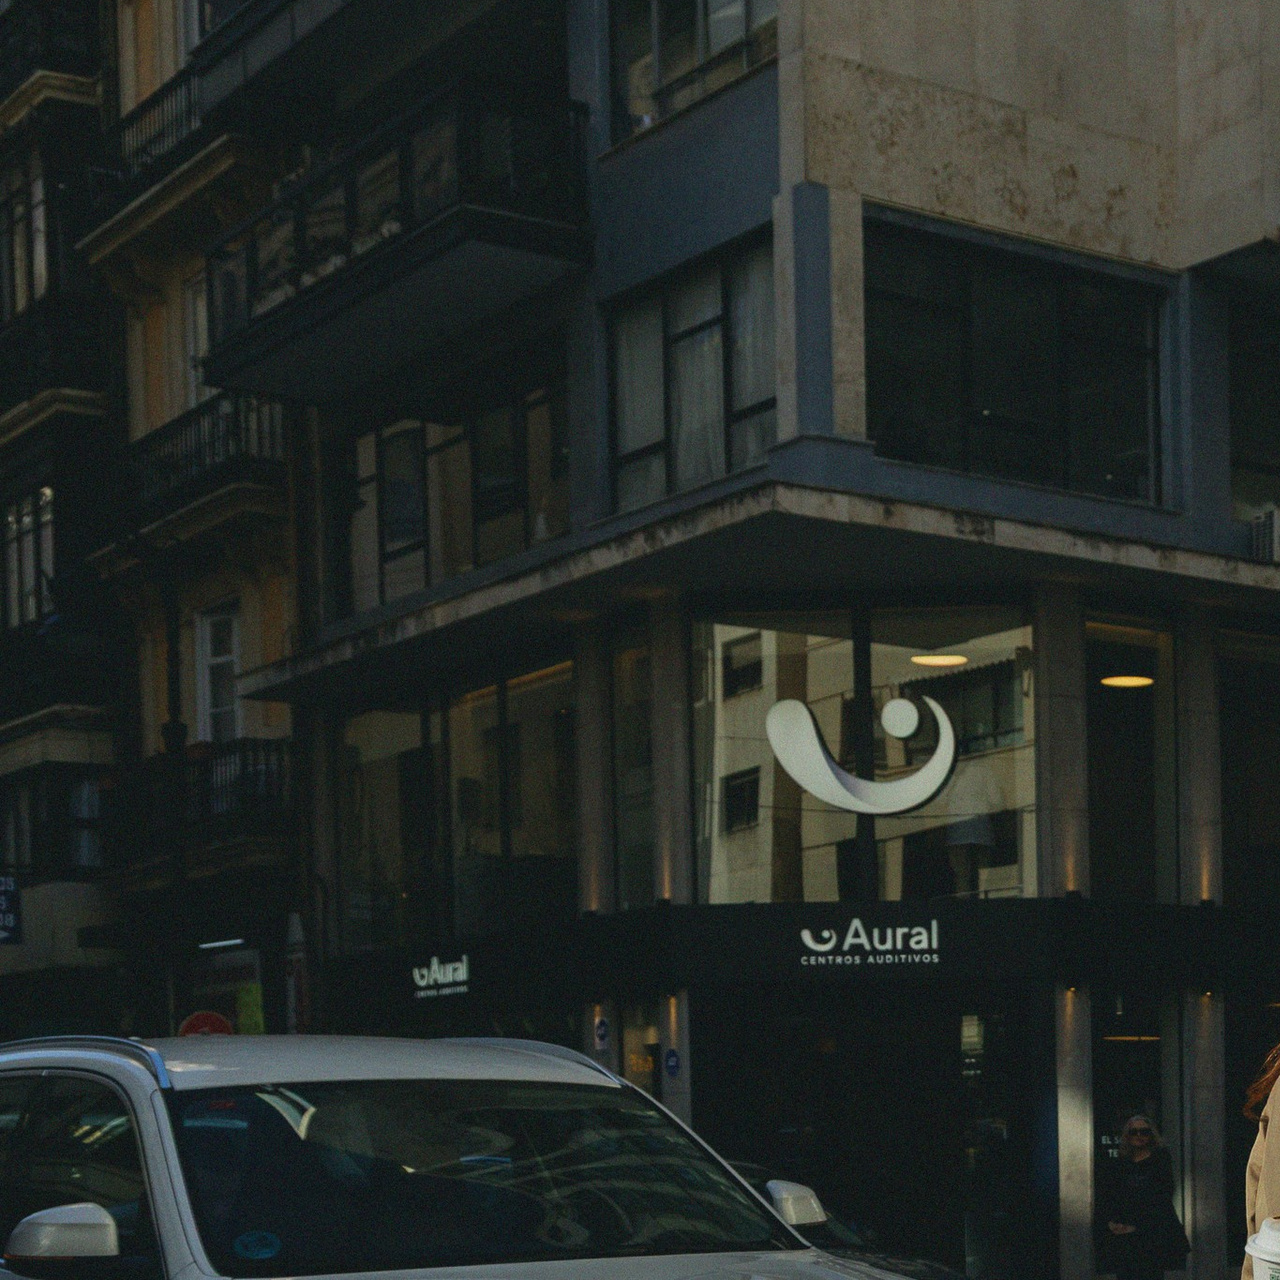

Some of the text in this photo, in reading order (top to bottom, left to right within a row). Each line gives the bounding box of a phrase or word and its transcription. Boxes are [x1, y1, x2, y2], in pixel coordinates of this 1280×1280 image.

[842, 917, 939, 952] Aural
[429, 954, 468, 986] Aural
[800, 953, 940, 966] CENTROS AUDITIVOS
